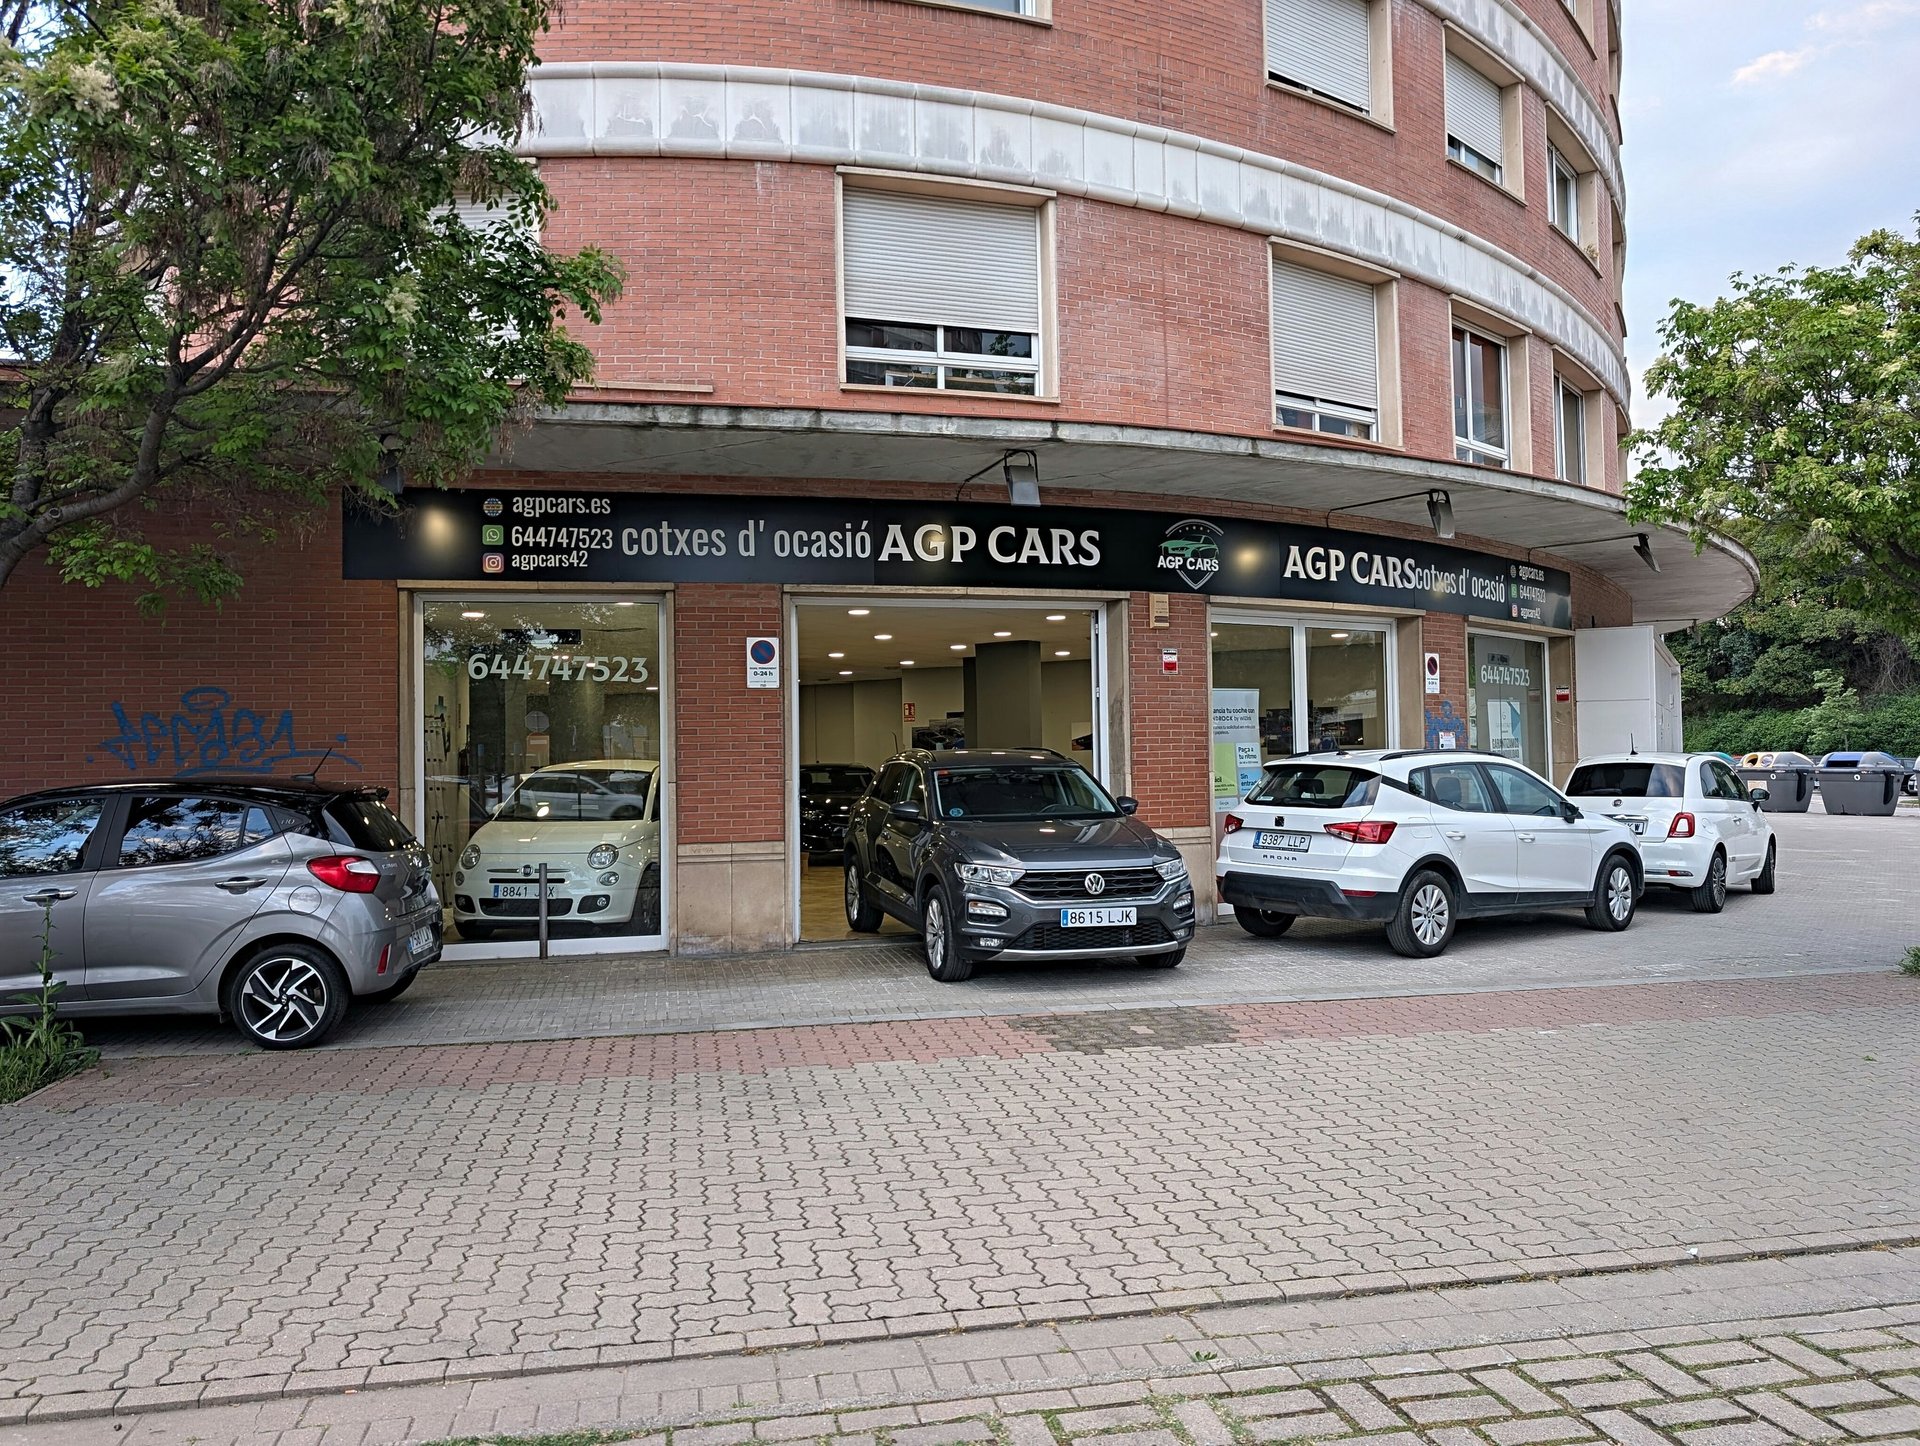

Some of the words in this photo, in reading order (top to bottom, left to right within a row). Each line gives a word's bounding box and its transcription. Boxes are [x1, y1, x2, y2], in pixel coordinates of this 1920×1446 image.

[513, 497, 611, 517] agpcars.es
[511, 526, 613, 549] 644747523
[621, 521, 726, 556] cotxes
[738, 520, 765, 557] d'
[774, 520, 871, 558] ocasió
[878, 524, 977, 562] AGP
[988, 525, 1101, 567] CARS
[511, 550, 588, 570] agpcars42
[1157, 555, 1183, 569] AGP
[1186, 557, 1219, 572] CARS
[1283, 545, 1346, 582] AGP
[1350, 551, 1416, 590] CARS
[1415, 564, 1457, 594] cotxes
[1471, 575, 1505, 603] ocasió
[467, 653, 649, 683] 644747523
[1481, 664, 1530, 686] 644747523
[1261, 834, 1284, 846] 9387
[1287, 836, 1306, 848] LLP
[502, 886, 528, 897] 8841
[1069, 911, 1103, 924] 8615
[1108, 910, 1133, 923] LJK
